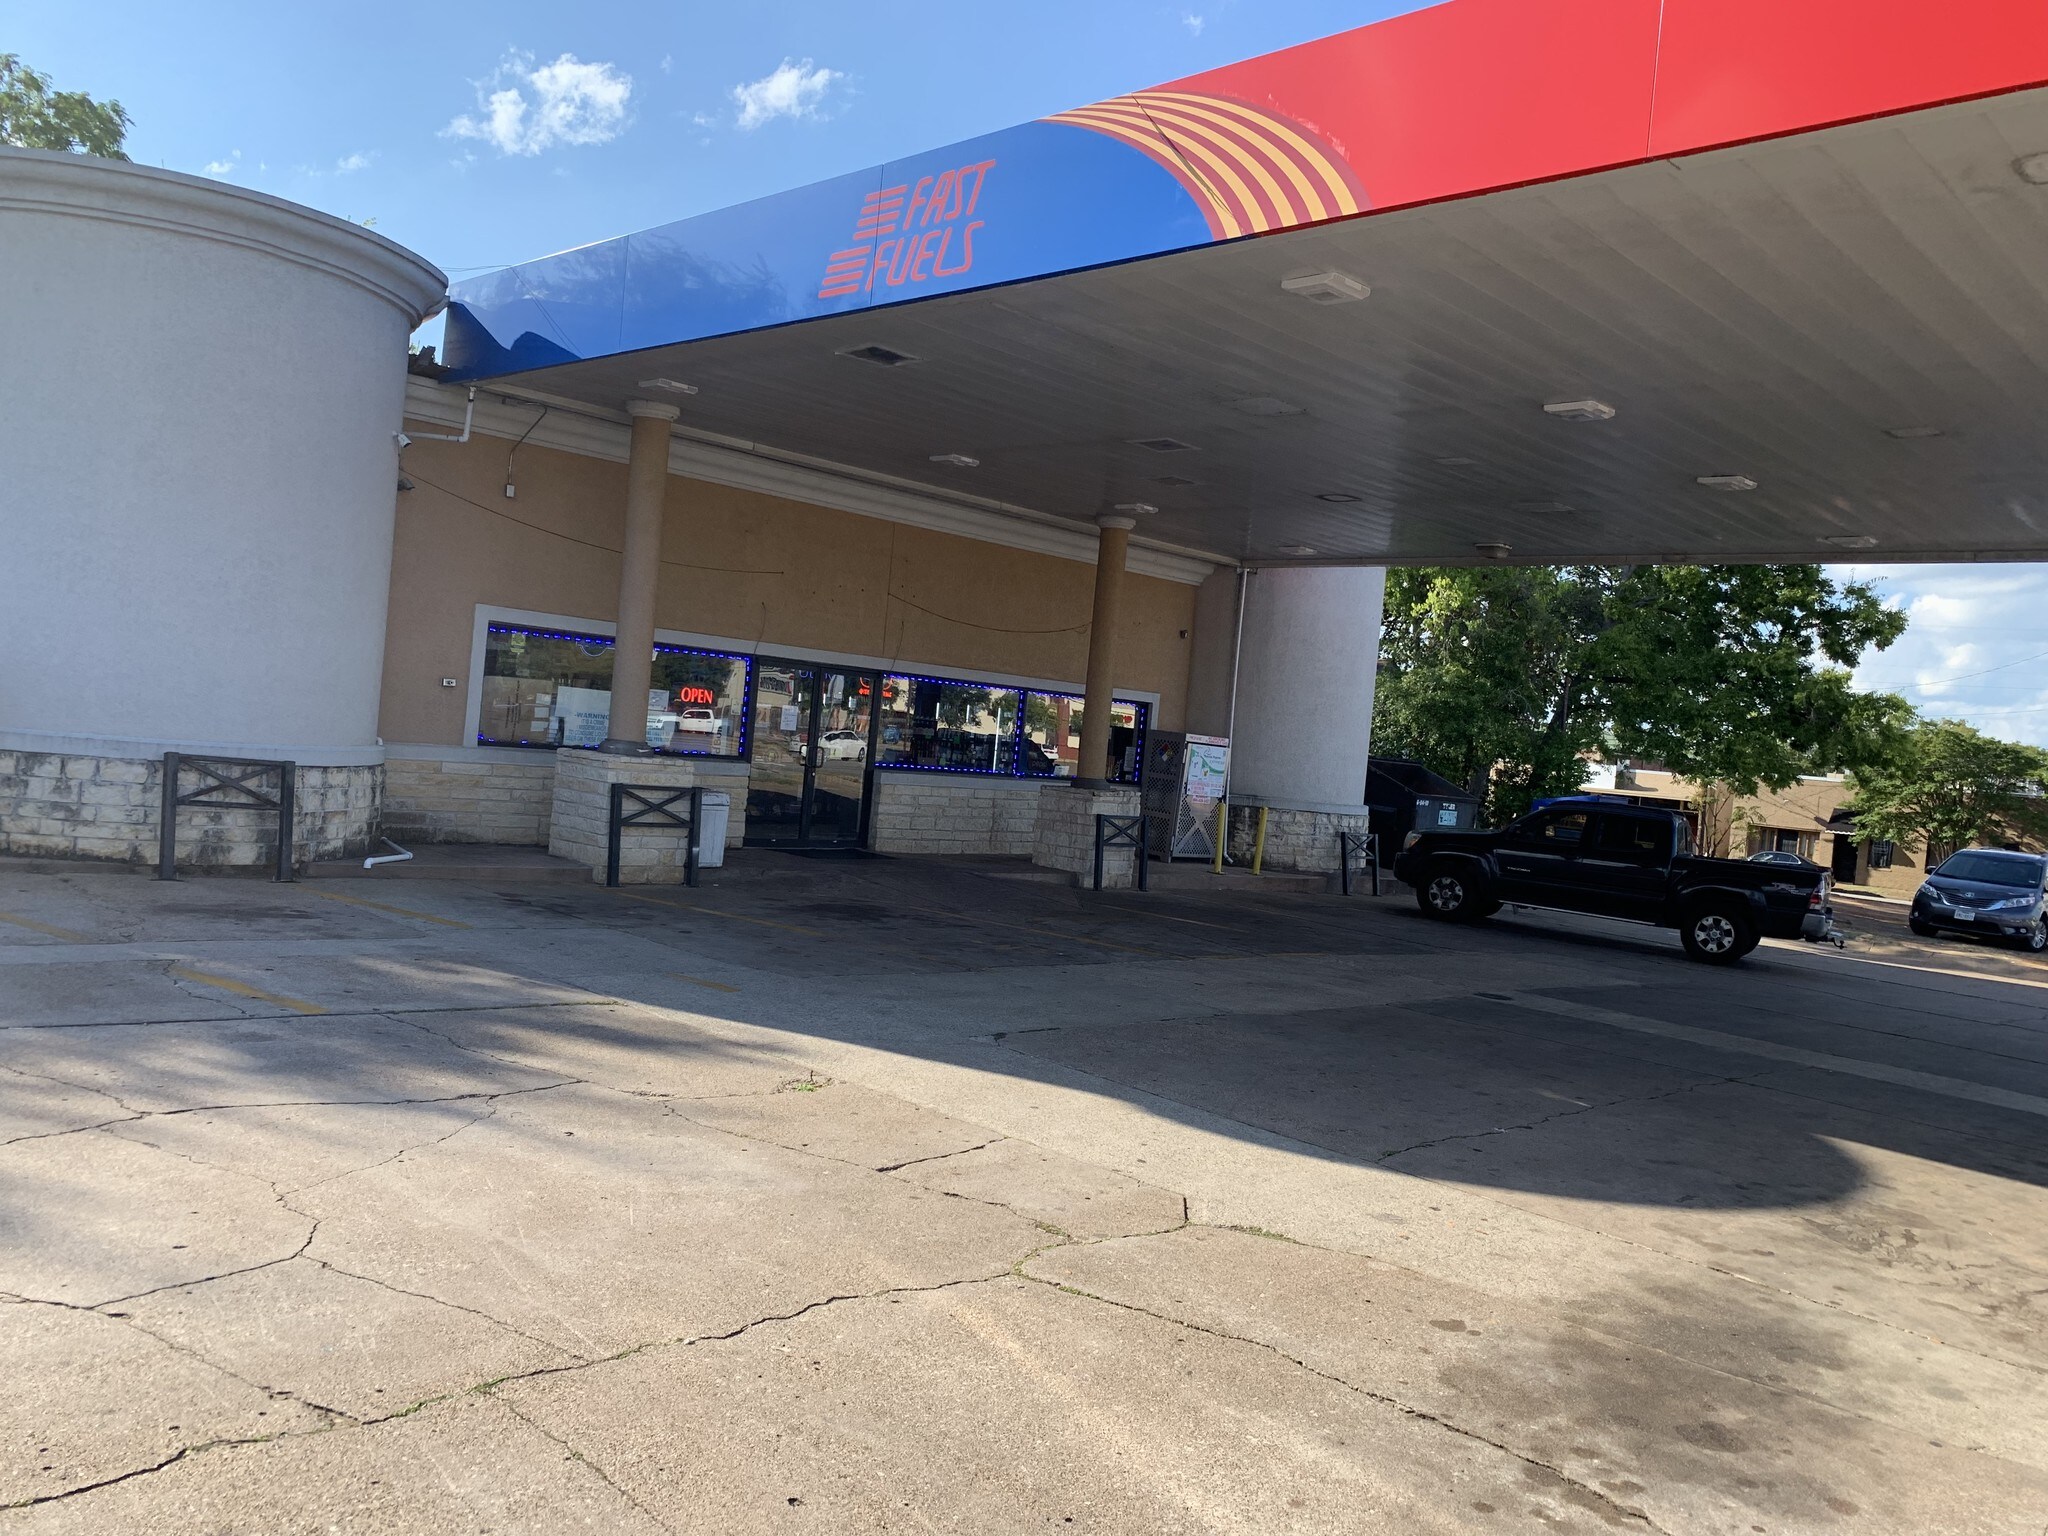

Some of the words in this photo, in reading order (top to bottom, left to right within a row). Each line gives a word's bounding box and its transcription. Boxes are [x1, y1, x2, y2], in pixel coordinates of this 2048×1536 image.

[902, 158, 996, 230] FAST
[864, 220, 985, 292] FUELS
[680, 687, 713, 705] OPEN
